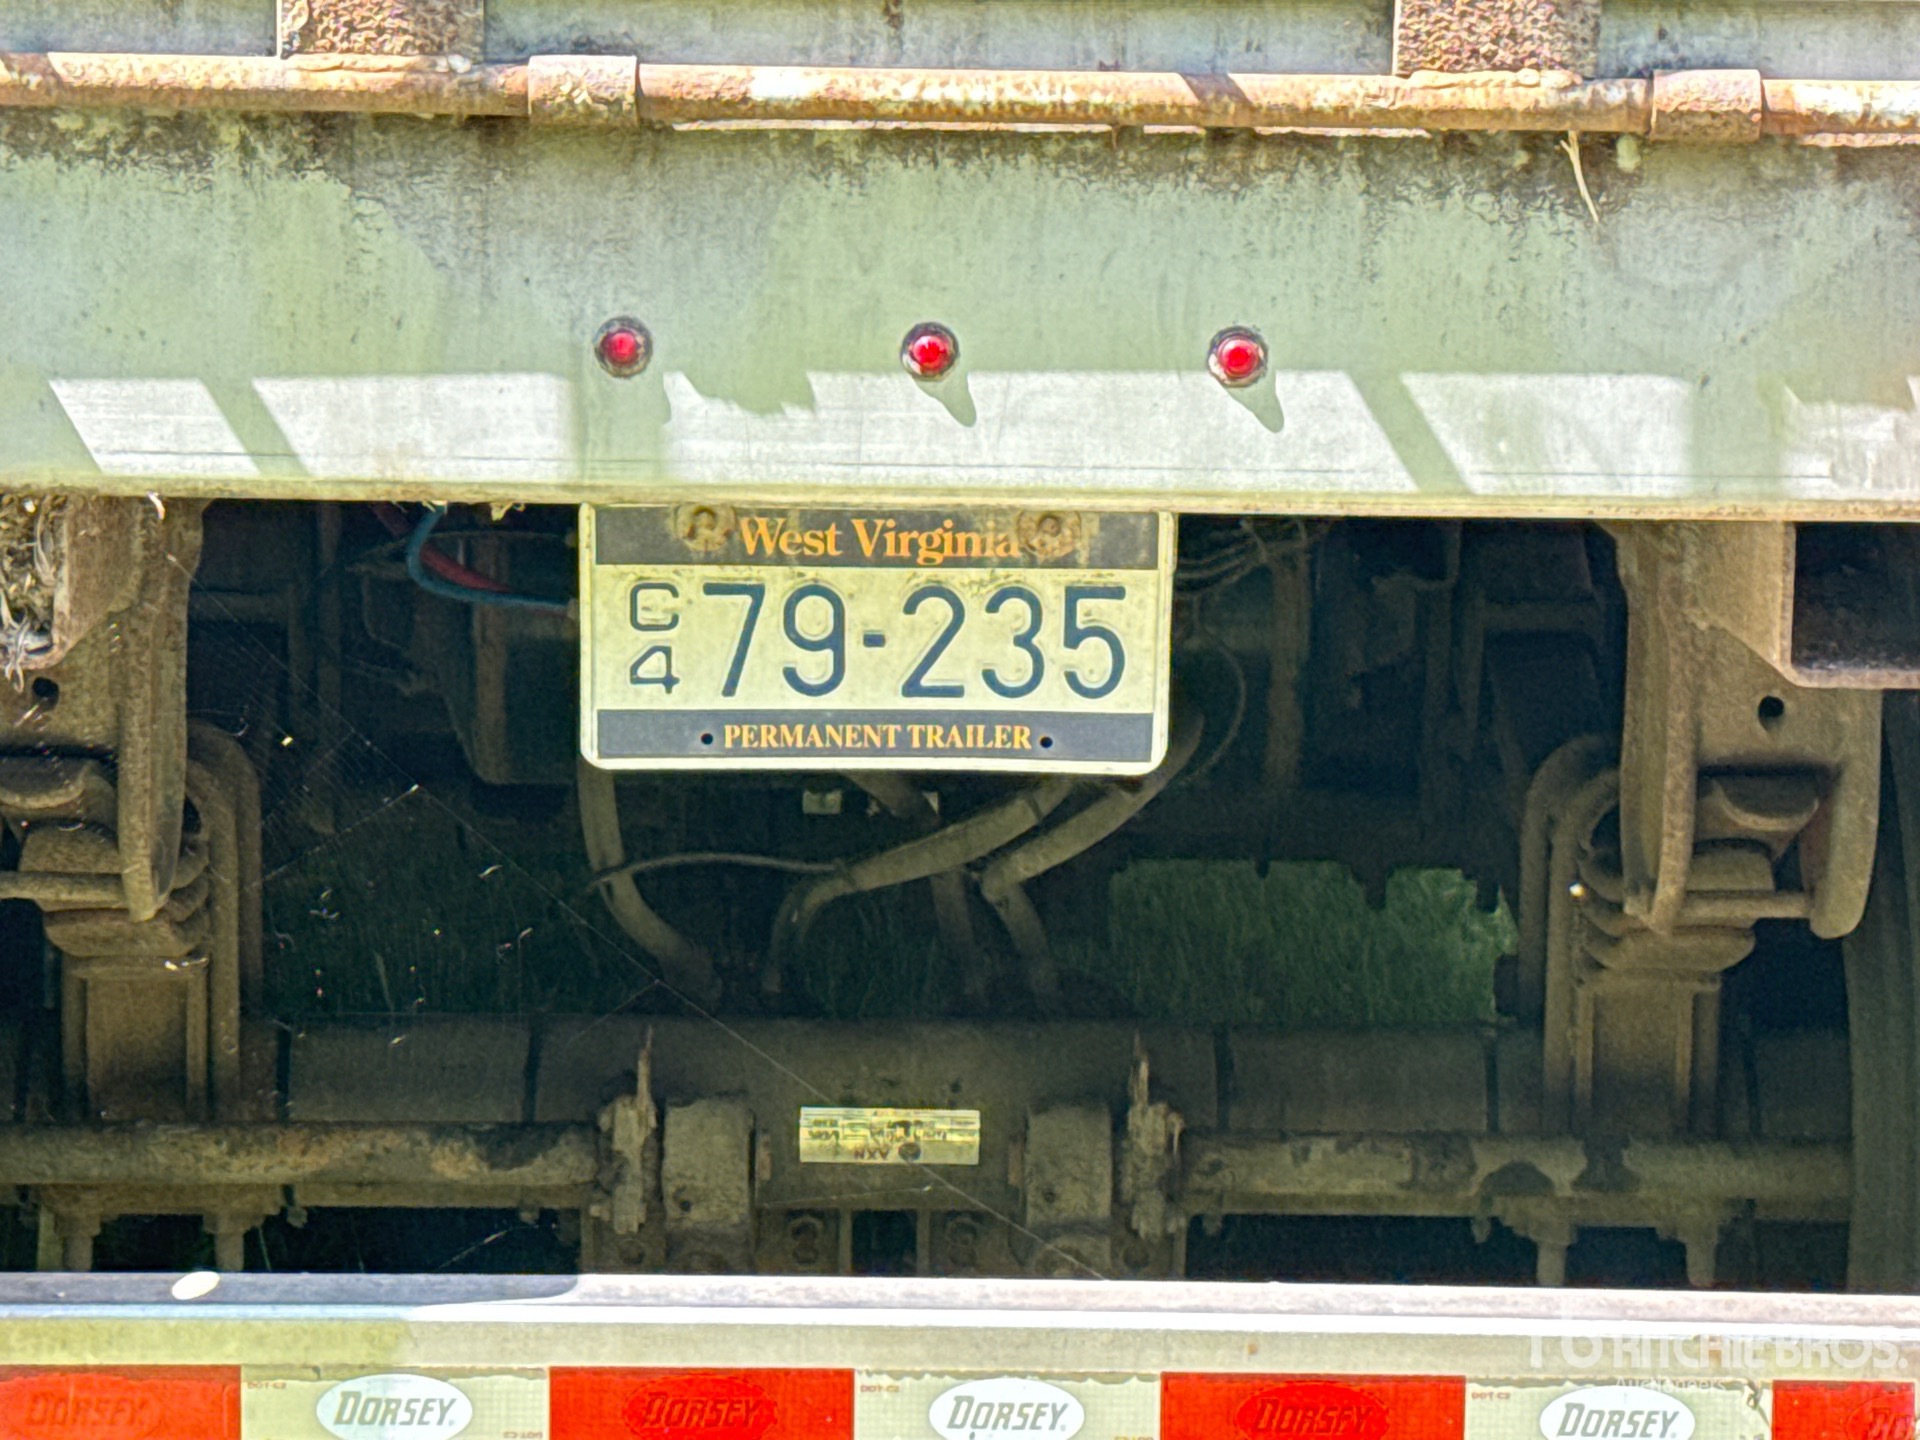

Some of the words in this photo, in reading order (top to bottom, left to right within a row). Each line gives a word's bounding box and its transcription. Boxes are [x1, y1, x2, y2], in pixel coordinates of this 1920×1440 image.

[740, 516, 839, 557] West
[852, 518, 1020, 566] Virginia
[702, 582, 1127, 699] 79-235
[724, 723, 901, 750] PERMANENT
[907, 724, 1032, 751] TRAILER
[333, 1390, 457, 1426] DORSEY
[642, 1390, 762, 1427] DORSEY
[946, 1395, 1069, 1431] DORSEY
[1252, 1398, 1372, 1434] DORSEY
[1556, 1402, 1680, 1439] DORSEY
